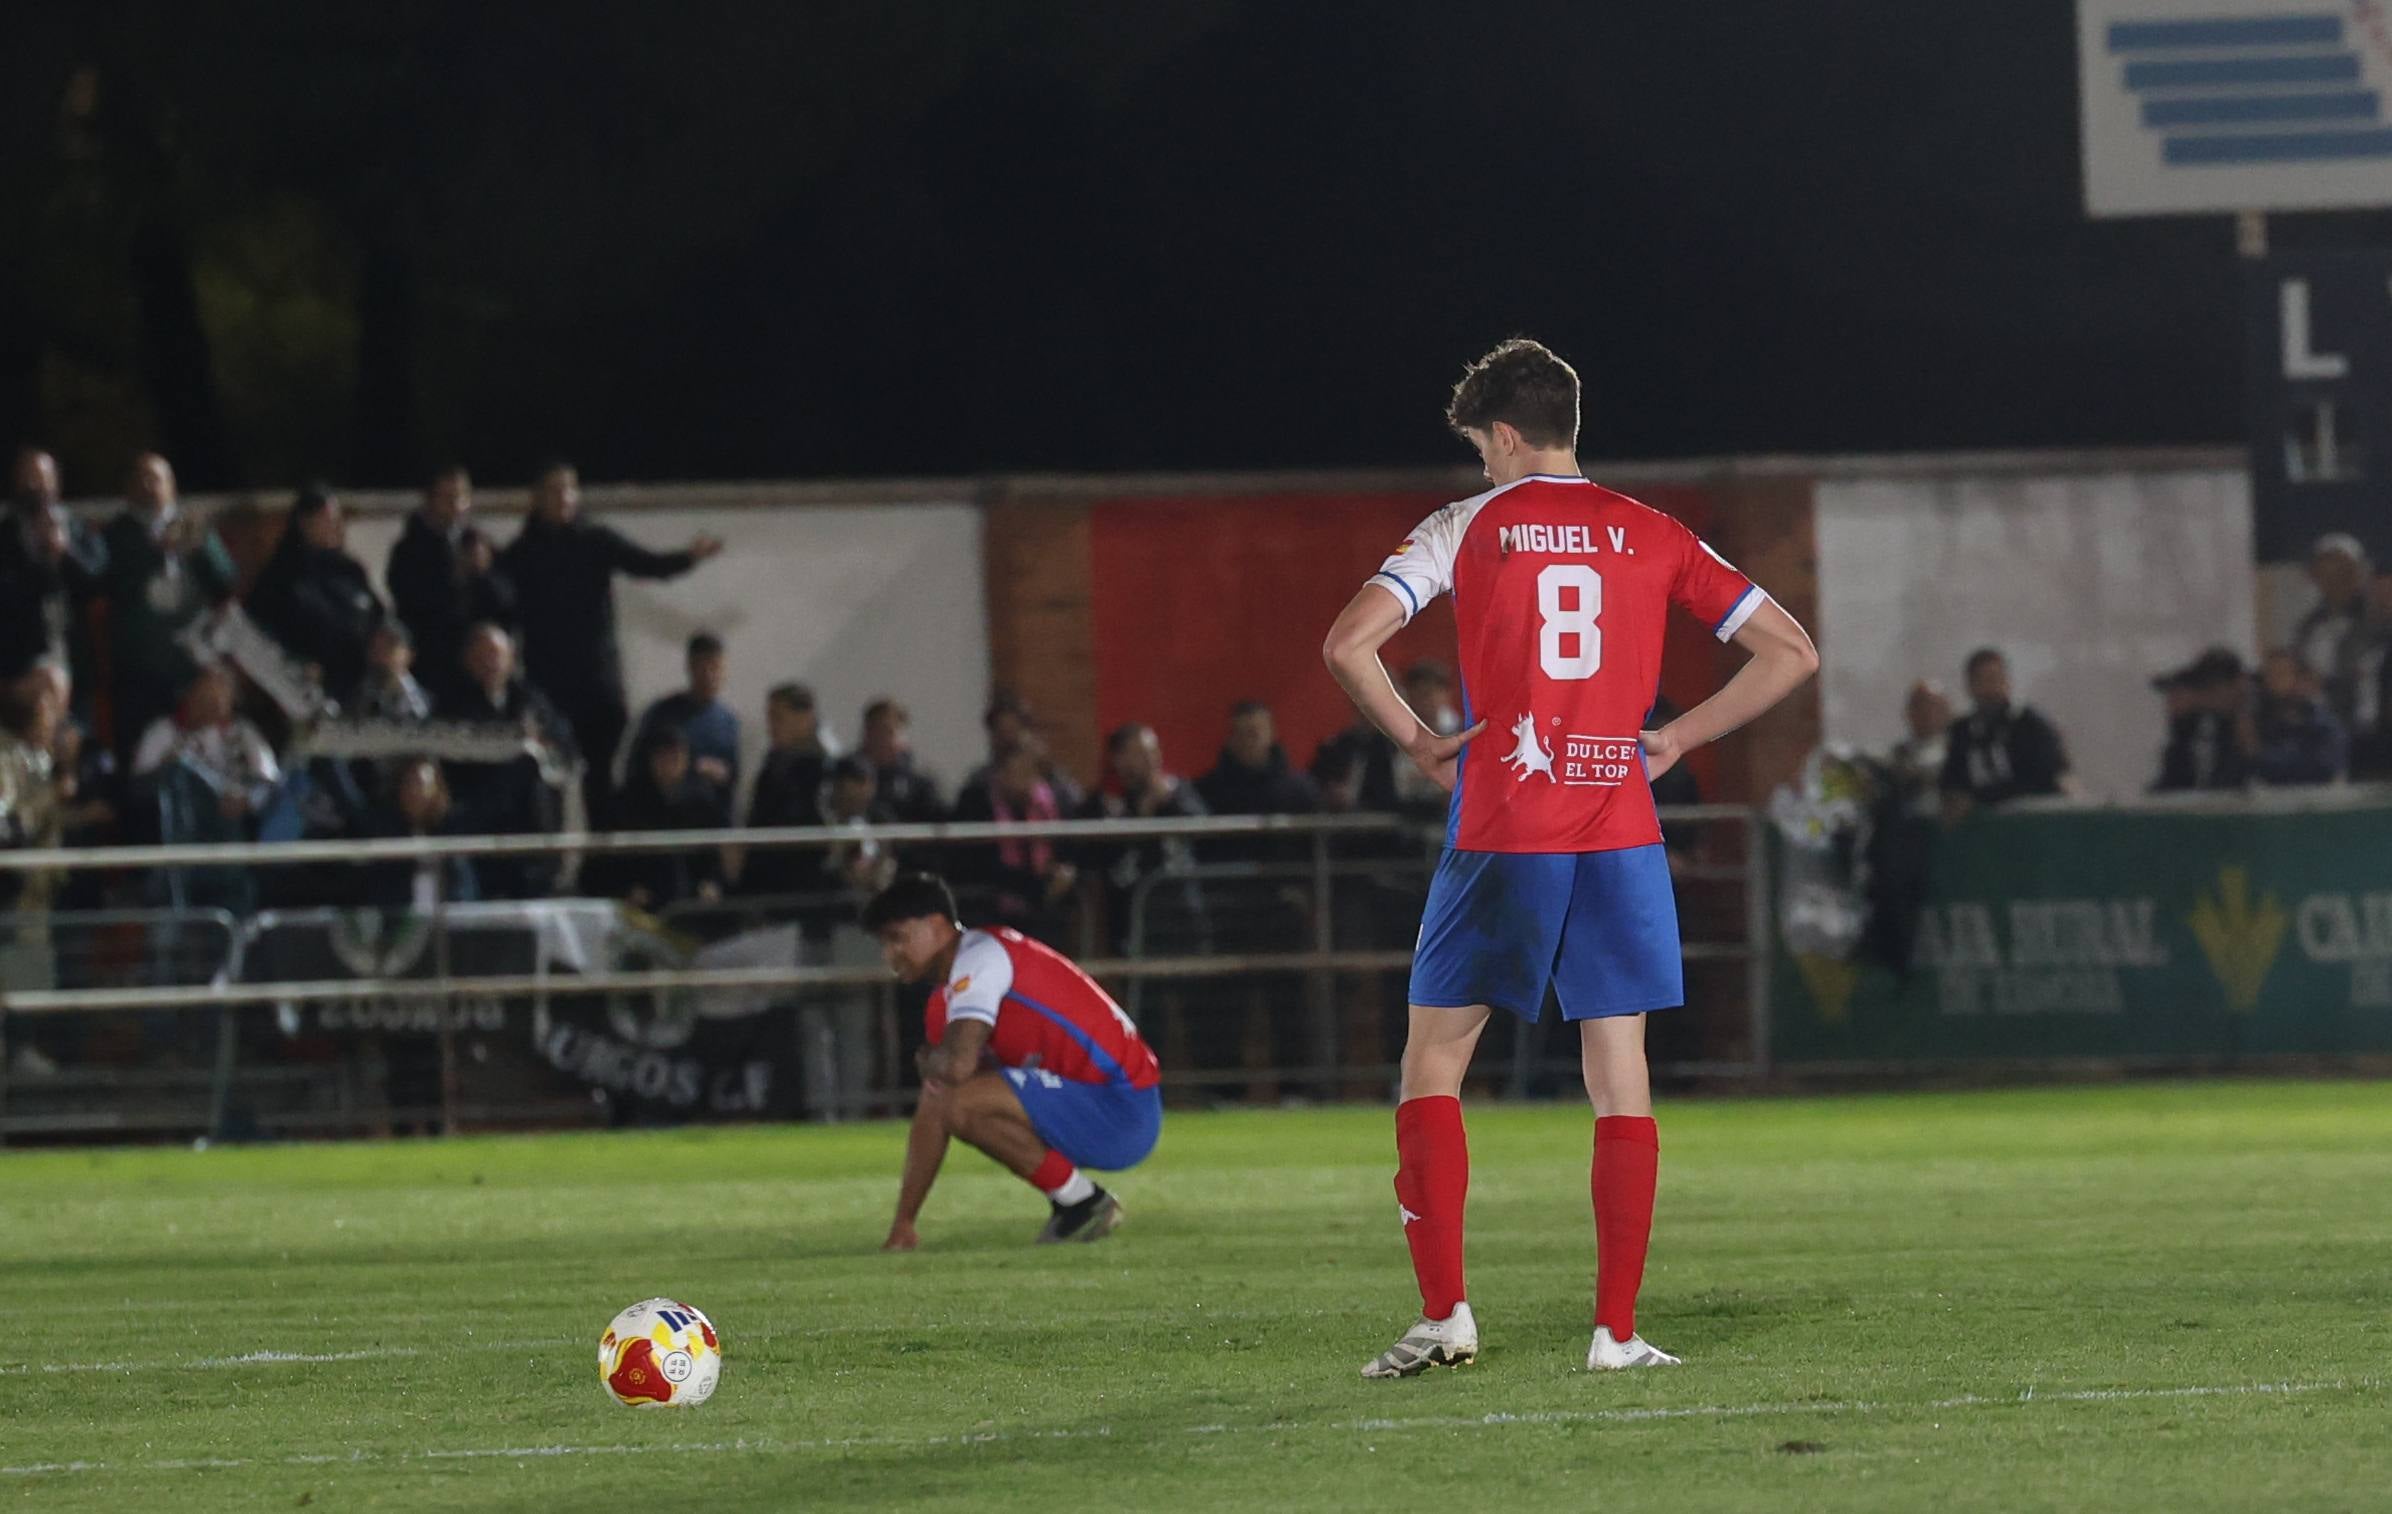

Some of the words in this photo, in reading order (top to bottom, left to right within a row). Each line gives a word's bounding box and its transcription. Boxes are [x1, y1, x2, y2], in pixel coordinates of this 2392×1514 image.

[1499, 523, 1599, 554] MIGUEL
[1606, 525, 1635, 555] V.
[1537, 564, 1602, 680] 8
[1565, 762, 1587, 778] EL
